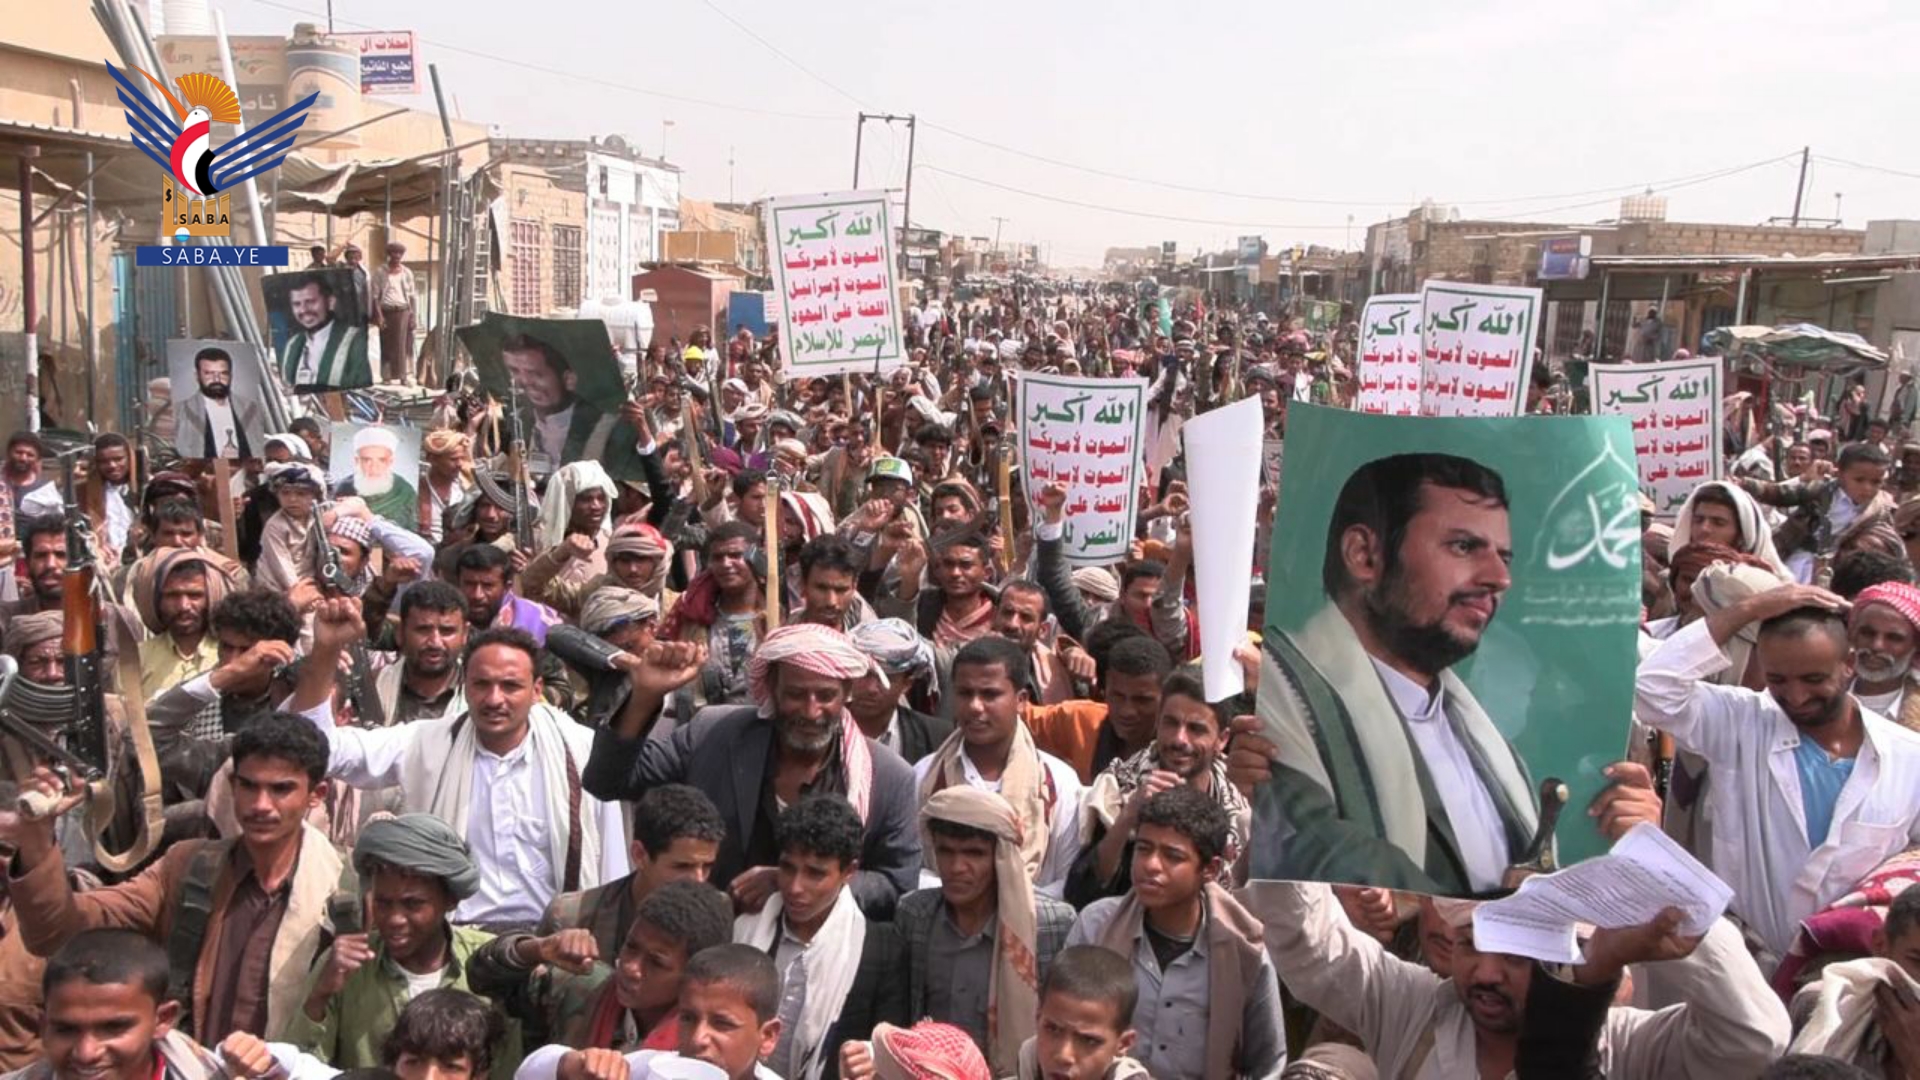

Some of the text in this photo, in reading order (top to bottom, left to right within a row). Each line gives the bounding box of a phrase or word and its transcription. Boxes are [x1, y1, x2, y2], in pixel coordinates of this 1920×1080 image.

[784, 208, 882, 249] الله أكبر
[784, 245, 884, 272] الموت لأمريكا
[788, 273, 887, 301] الموت لإسرائيل
[791, 304, 828, 328] اليهود
[832, 303, 852, 323] على
[857, 299, 889, 319] اللعنة
[1426, 297, 1525, 337] الله أكبر
[1366, 306, 1411, 343] أكبر
[794, 322, 893, 358] النصر للإسلام
[1425, 340, 1463, 365] لأمريك
[1466, 348, 1519, 371] الموت
[1463, 380, 1514, 403] الموت
[1603, 374, 1709, 410] الله أكبر
[1029, 391, 1135, 428] الله أكبر
[1662, 408, 1709, 430] الموت
[1028, 429, 1132, 460] الموت لأمريكا
[1663, 434, 1710, 456] الموت
[1029, 459, 1130, 490] الموت لإسرائيل
[1646, 463, 1669, 482] على
[1675, 459, 1710, 478] اللعنة
[1065, 493, 1088, 517] على
[1093, 493, 1128, 513] اللعنة
[1079, 519, 1125, 552] النصر
